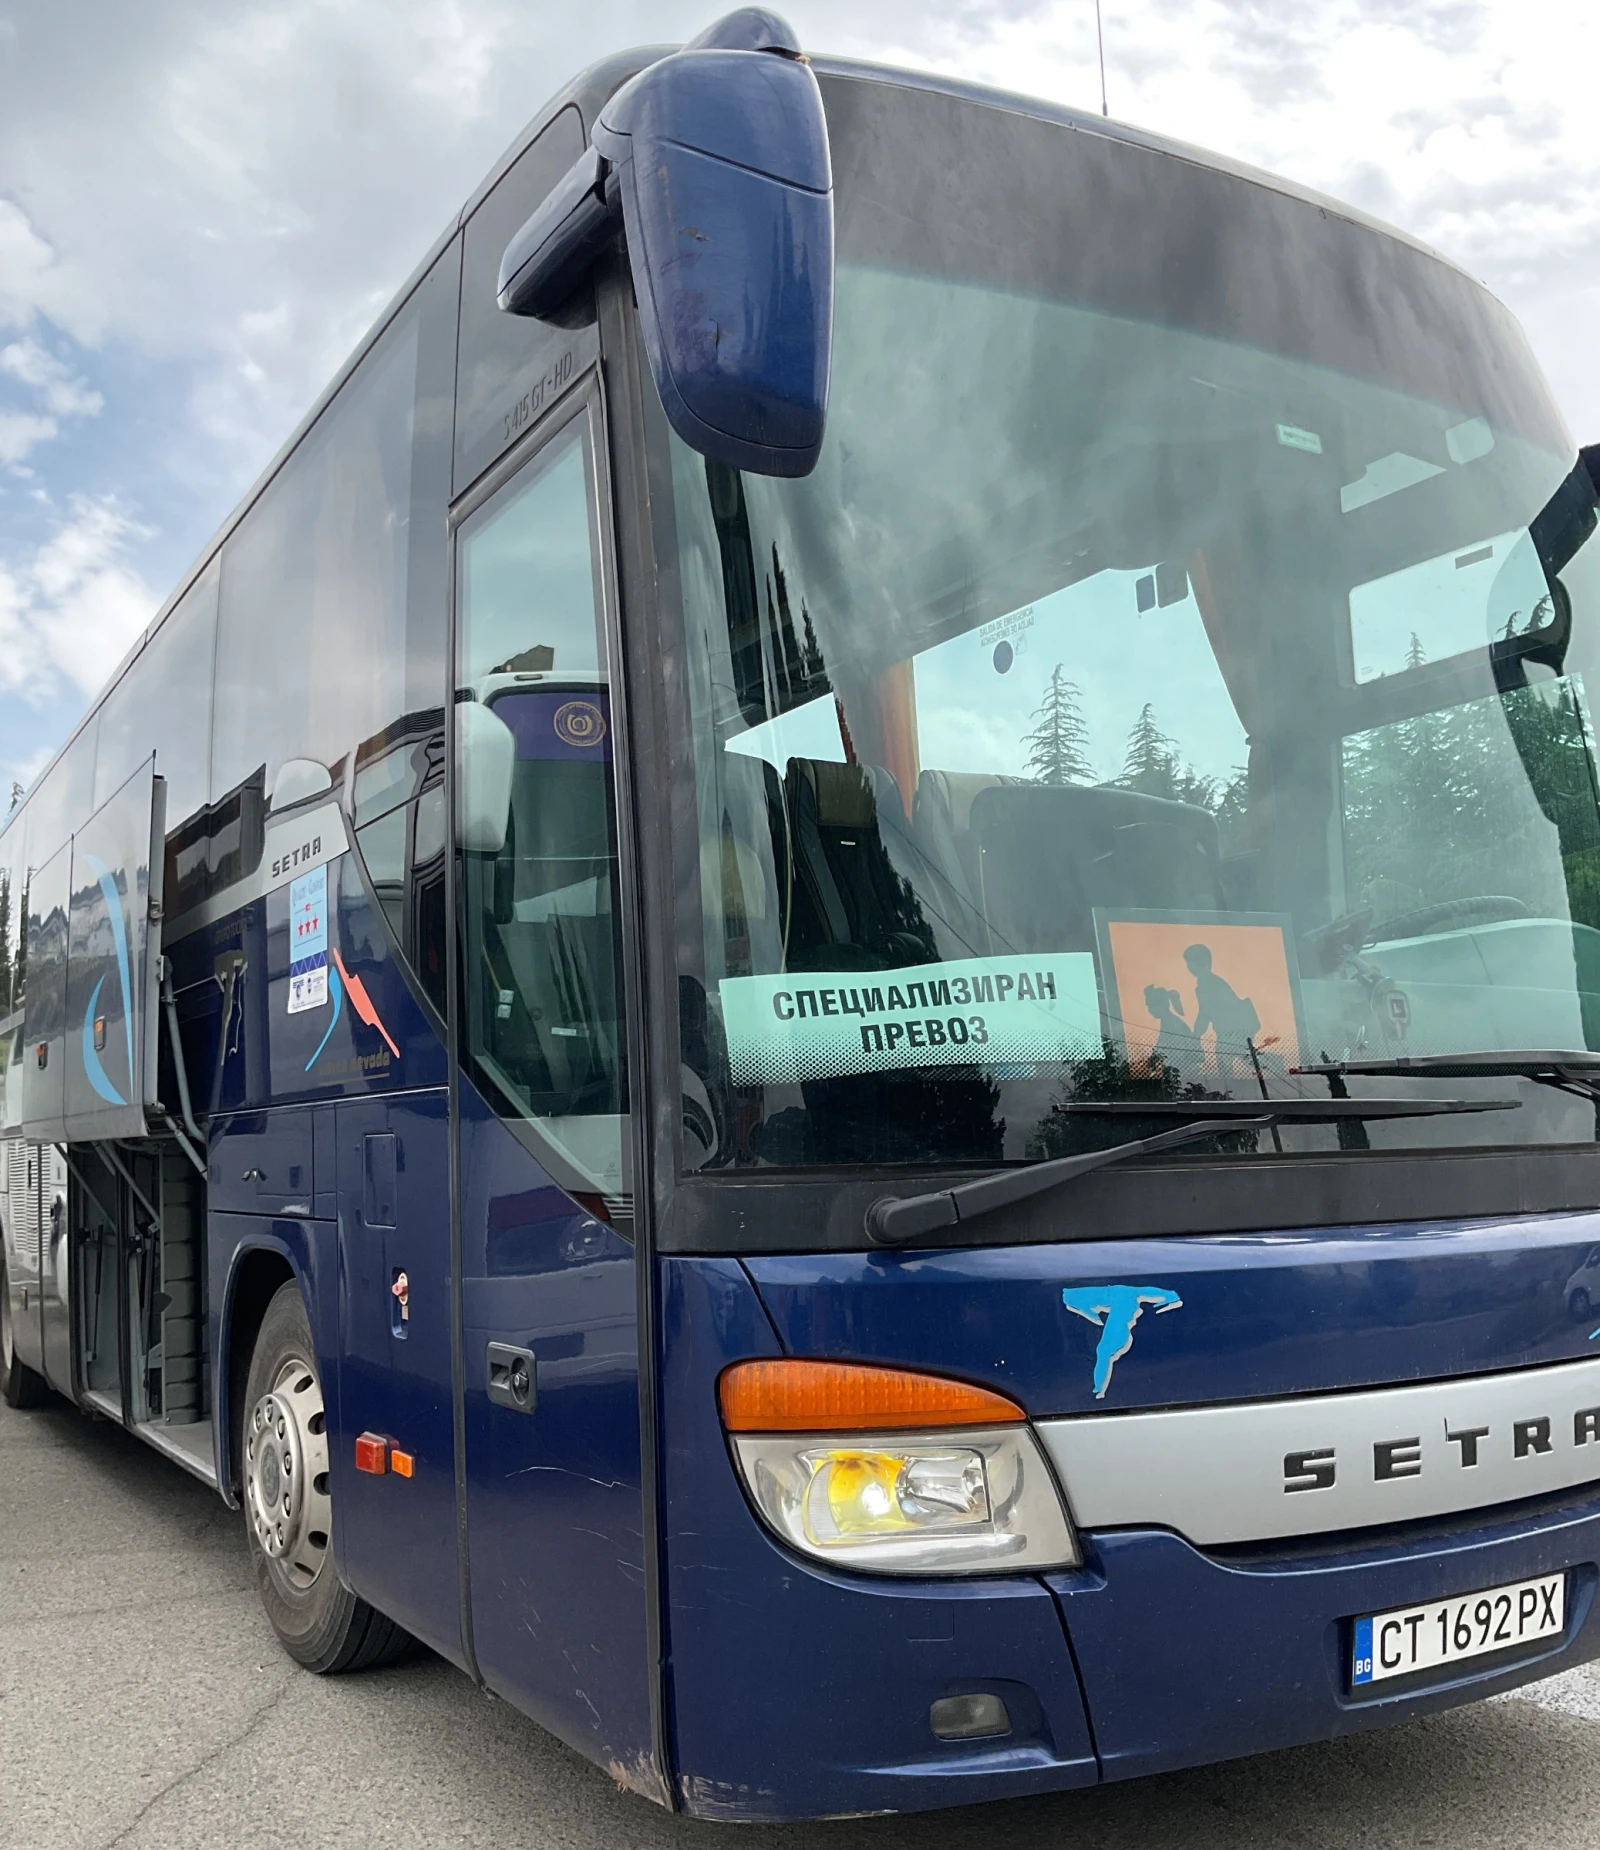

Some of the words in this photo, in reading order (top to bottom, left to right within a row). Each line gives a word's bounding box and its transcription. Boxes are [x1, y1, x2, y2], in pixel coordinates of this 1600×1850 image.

[512, 393, 529, 430] 415
[272, 835, 322, 879] SETRA
[772, 971, 1058, 1020] СПЕЦИАЛИЗИРАН
[859, 1015, 990, 1054] ПРЕВОЗ
[1283, 1406, 1600, 1494] SETRA
[1355, 1657, 1372, 1676] BG
